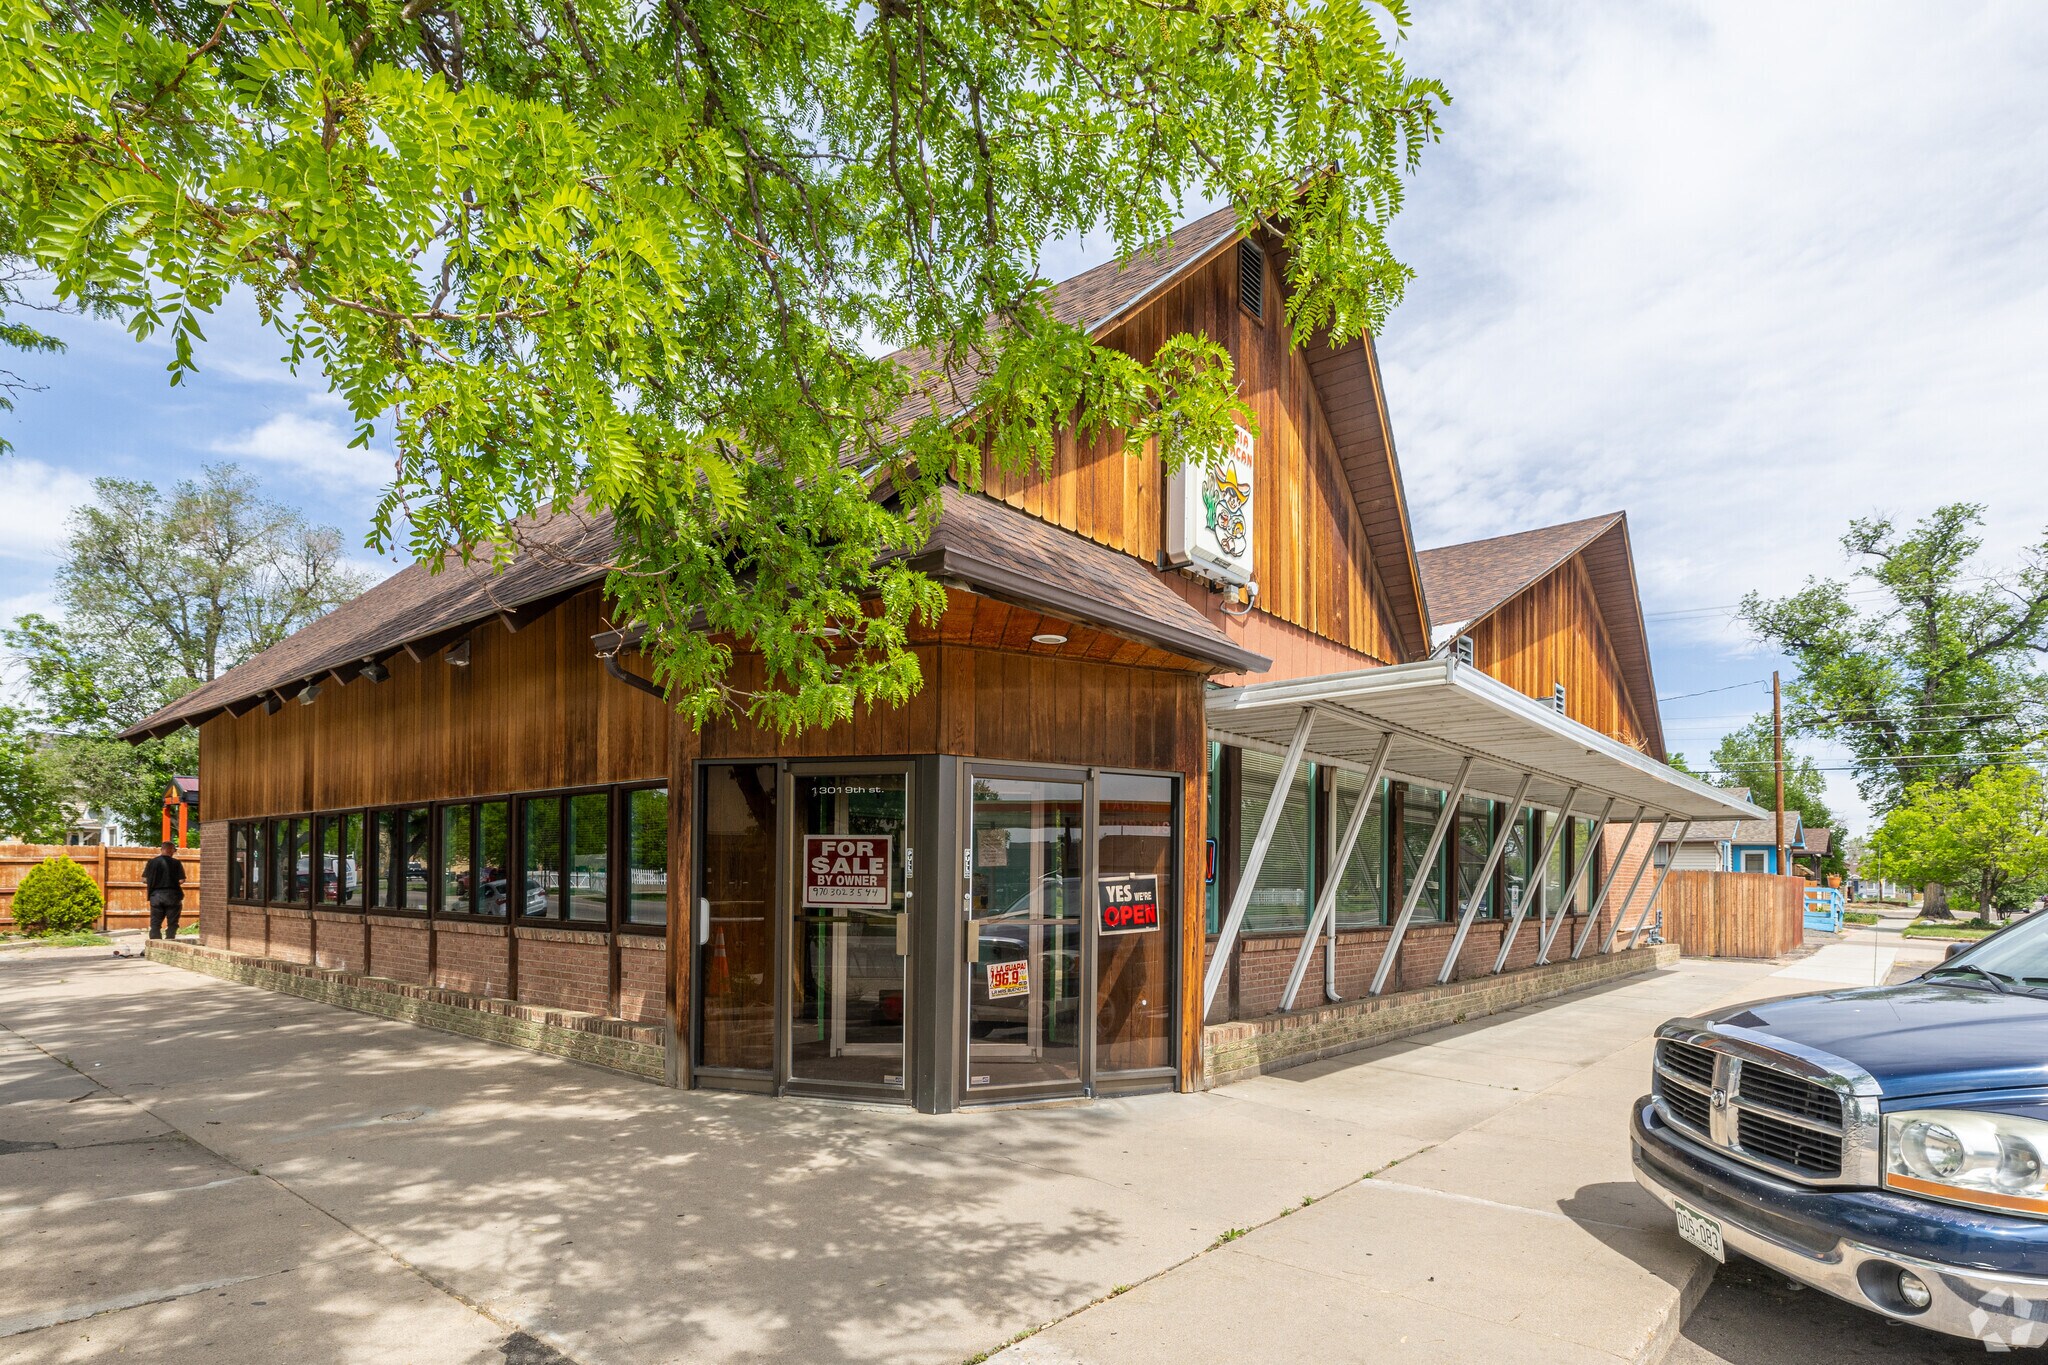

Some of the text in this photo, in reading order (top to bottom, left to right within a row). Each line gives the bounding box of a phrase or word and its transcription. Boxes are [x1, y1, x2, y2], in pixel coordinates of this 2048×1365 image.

[811, 786, 884, 795] 1301 9th st.
[822, 841, 874, 857] FOR
[811, 857, 884, 875] SALE
[817, 875, 878, 886] BY OWNER
[1105, 884, 1152, 903] YES WE'RE
[1104, 903, 1157, 927] OPEN
[996, 965, 1004, 973] LA
[994, 970, 1019, 986] 96.9
